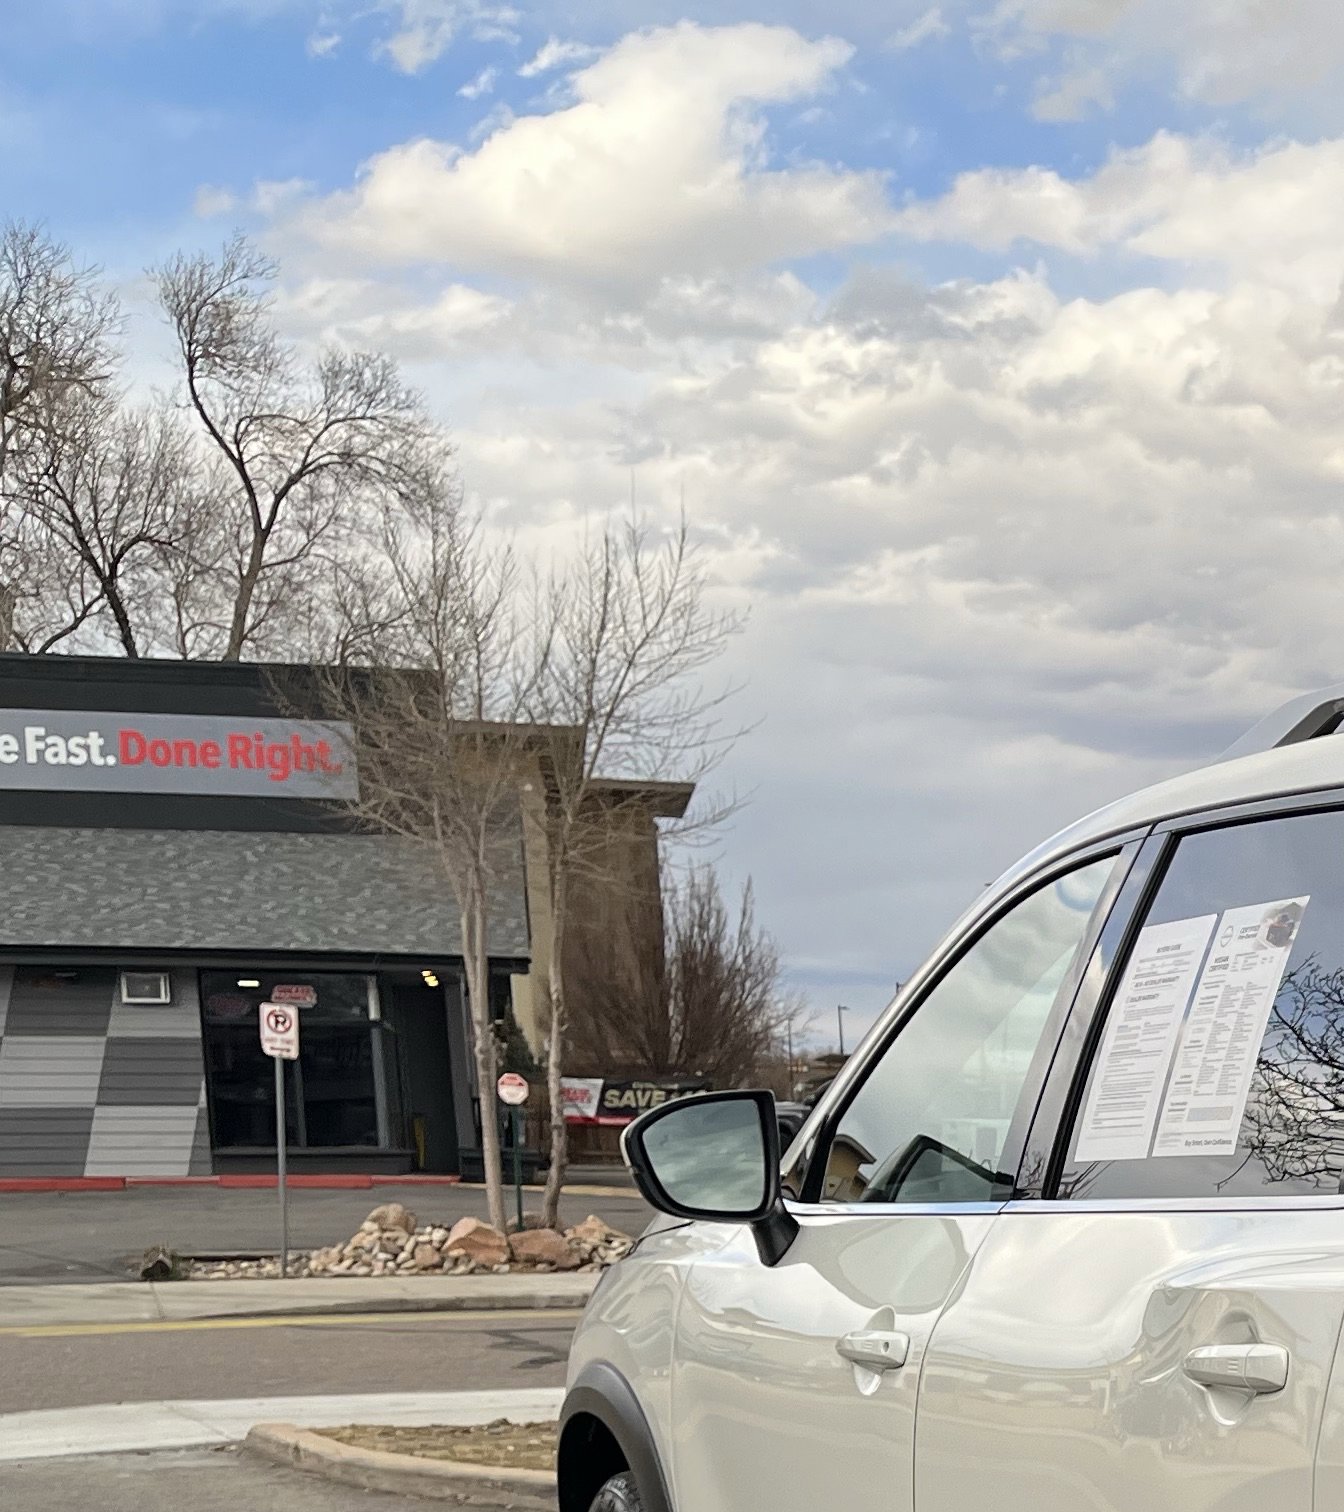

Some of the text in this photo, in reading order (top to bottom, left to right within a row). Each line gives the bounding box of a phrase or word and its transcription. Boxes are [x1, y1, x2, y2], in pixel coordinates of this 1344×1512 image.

[24, 726, 117, 767] Fast.
[118, 728, 222, 770] Done
[226, 730, 345, 782] Right.
[602, 1088, 666, 1109] SAVE
